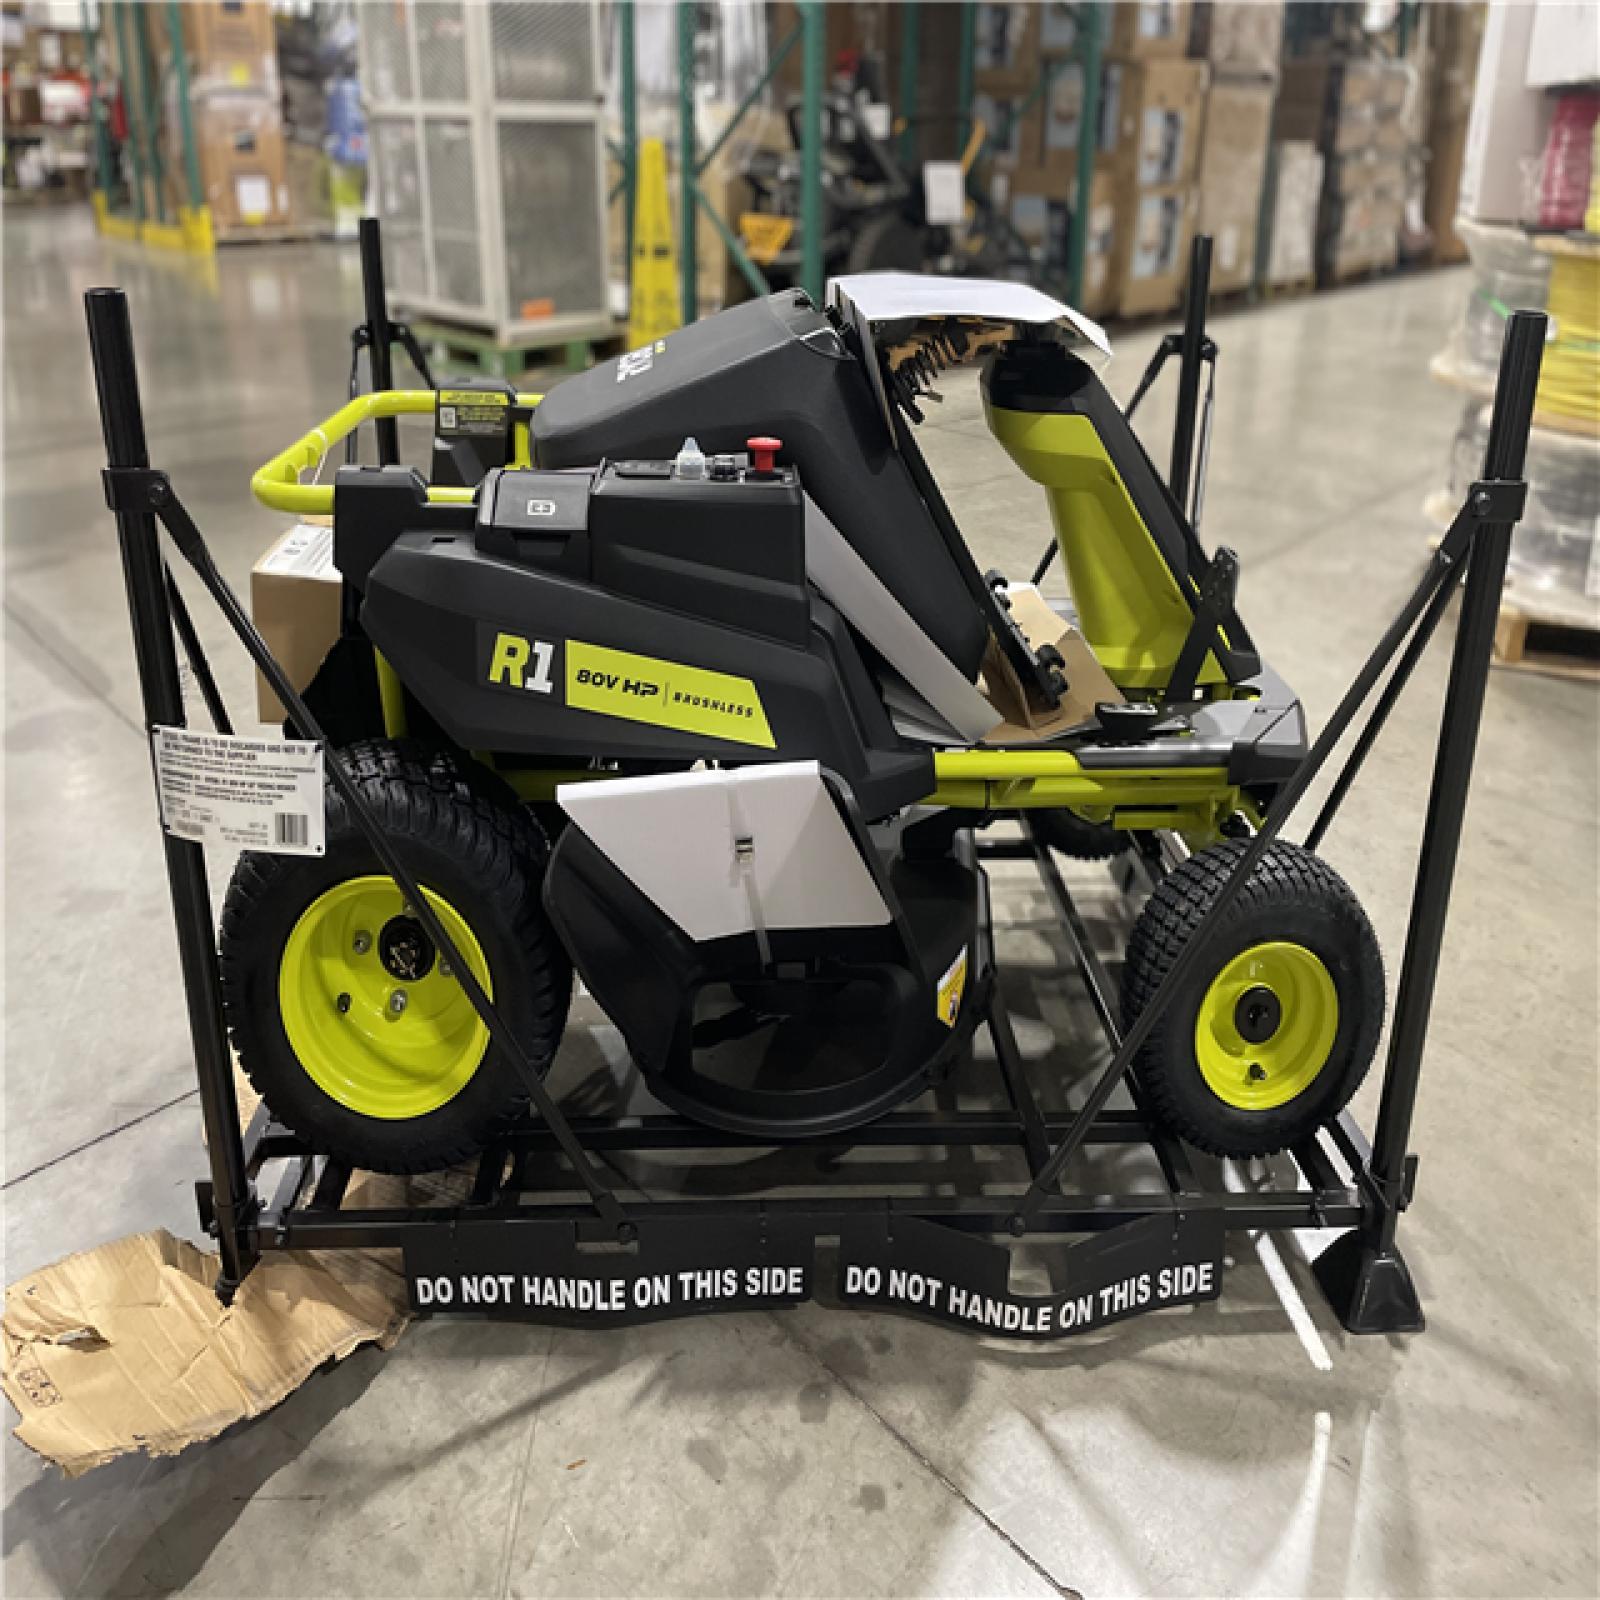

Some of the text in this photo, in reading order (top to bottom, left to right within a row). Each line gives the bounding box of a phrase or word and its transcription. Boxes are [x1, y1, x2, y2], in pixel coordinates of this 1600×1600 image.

[489, 632, 553, 693] R1
[576, 669, 753, 717] 80V HP BRUSHLESS
[417, 1268, 802, 1310] DO NOT HANDLE ON THIS SIDE
[847, 1263, 1213, 1331] DO NOT HANDLE ON THIS SIDE
